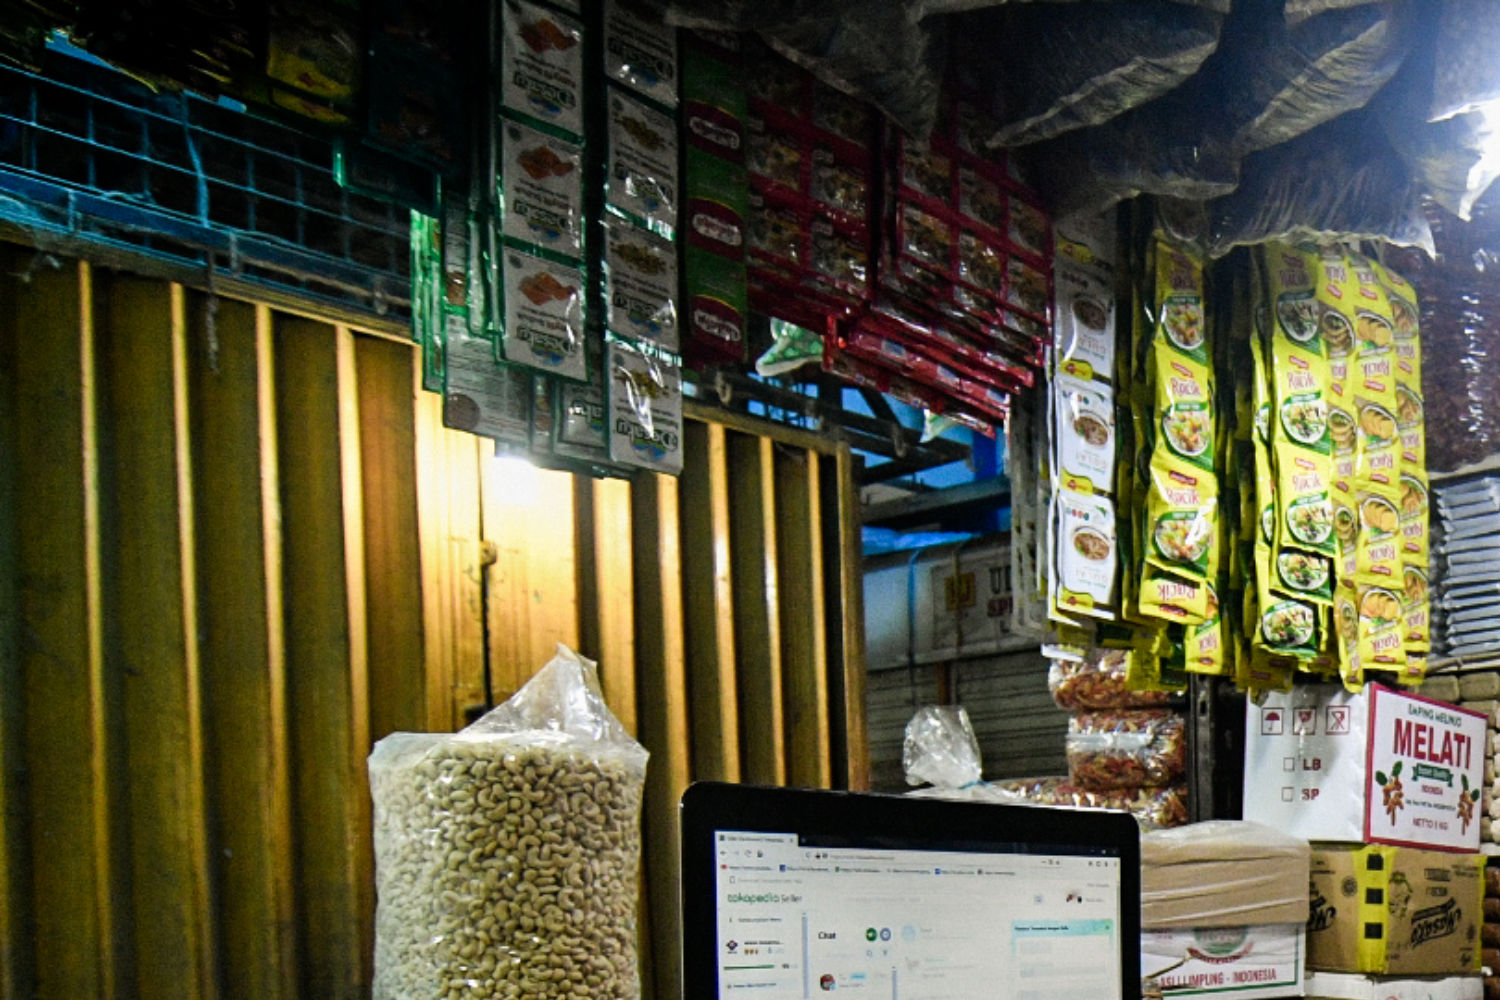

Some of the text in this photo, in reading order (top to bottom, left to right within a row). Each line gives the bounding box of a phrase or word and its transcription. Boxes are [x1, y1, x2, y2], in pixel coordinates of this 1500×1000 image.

[1392, 718, 1472, 770] MELATI
[1303, 758, 1322, 771] LB
[727, 892, 780, 906] tokopedia
[818, 931, 837, 940] Chat
[1233, 968, 1277, 983] INDONESIA
